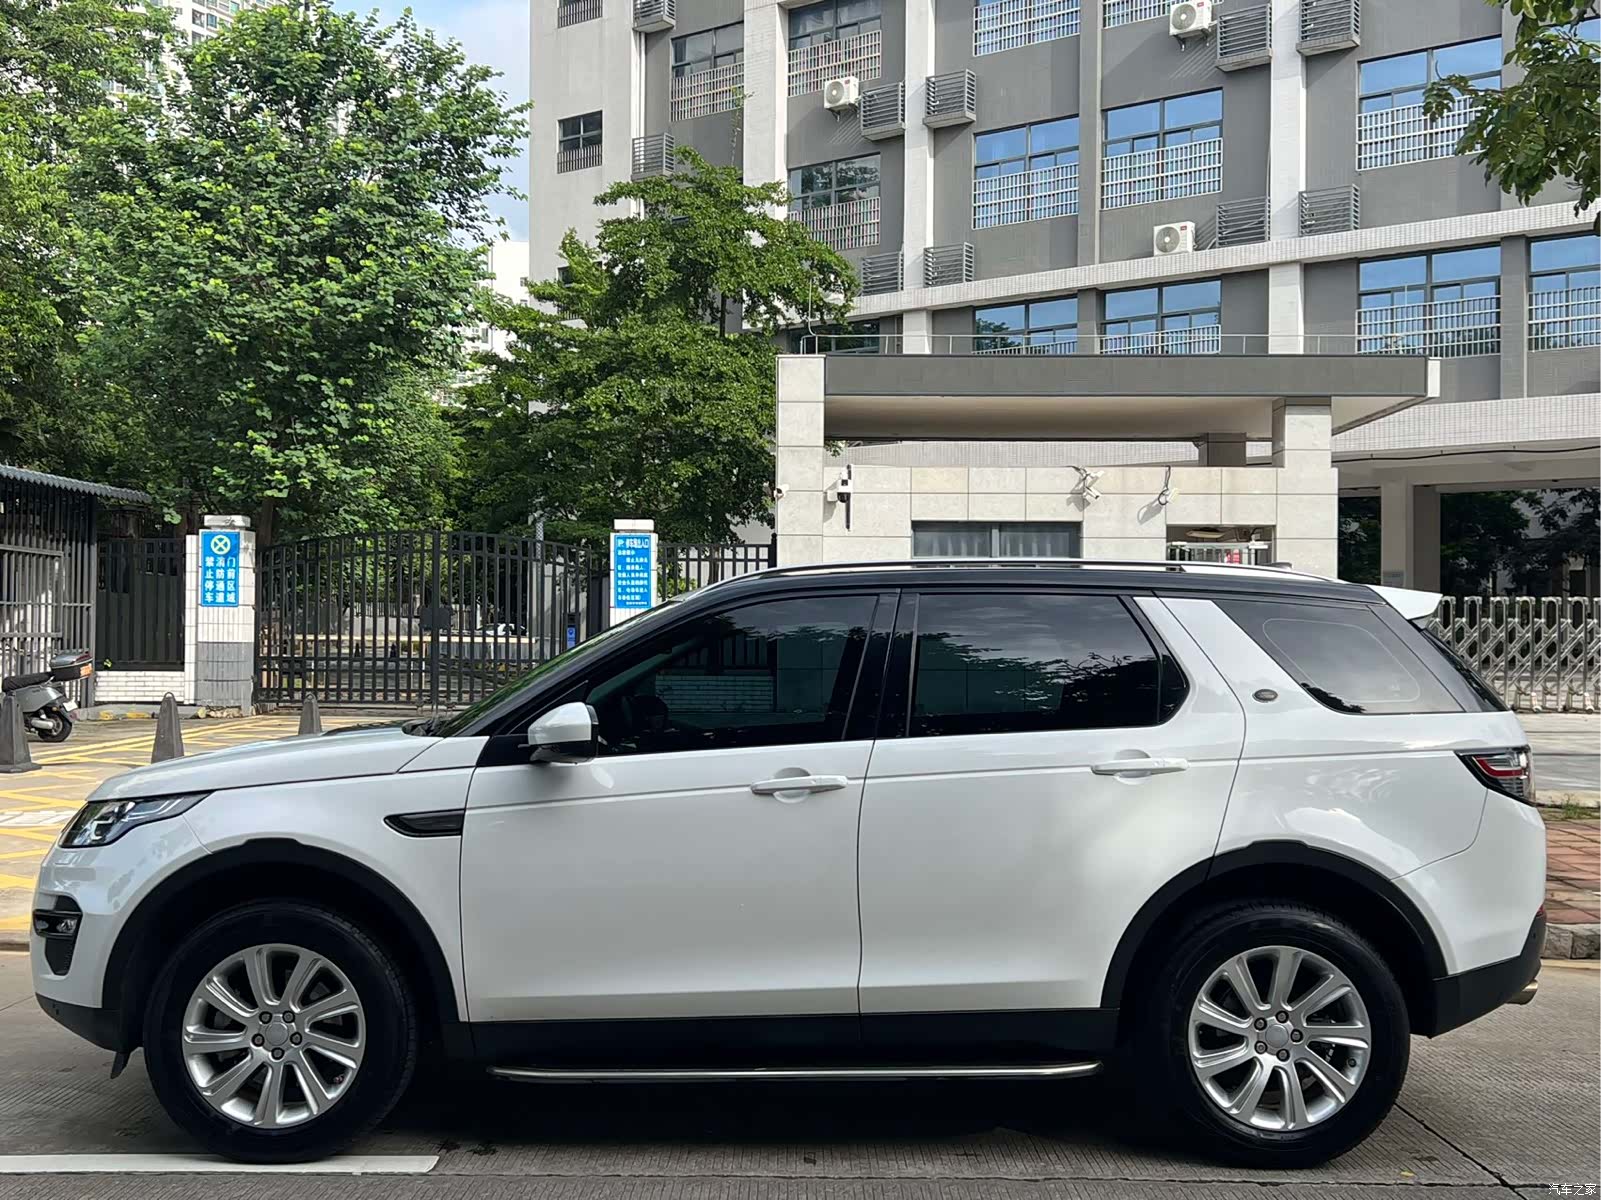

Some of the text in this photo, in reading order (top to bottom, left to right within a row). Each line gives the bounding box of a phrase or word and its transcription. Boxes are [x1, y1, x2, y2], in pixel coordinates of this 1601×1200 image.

[204, 557, 214, 603] 禁止停车
[216, 557, 225, 603] 消防通道
[226, 557, 236, 604] 门前区域
